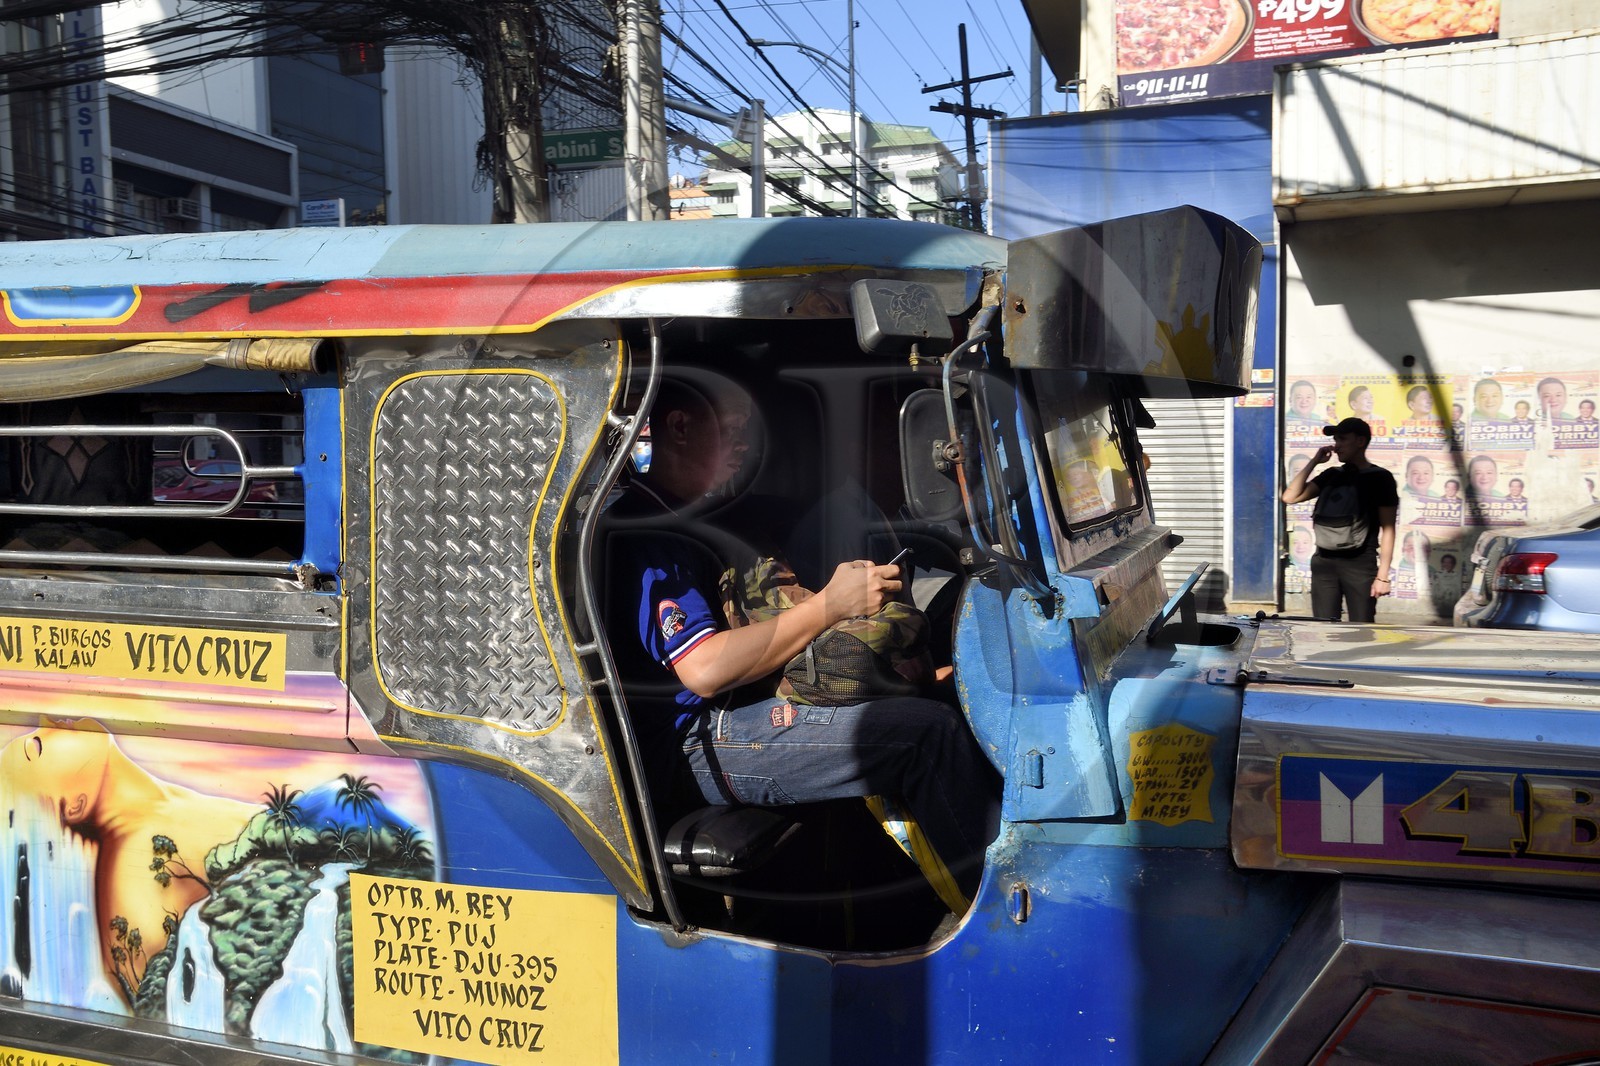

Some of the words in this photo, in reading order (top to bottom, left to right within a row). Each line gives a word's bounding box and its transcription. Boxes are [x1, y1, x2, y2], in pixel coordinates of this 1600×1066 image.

[1136, 73, 1209, 96] 911-11-11
[544, 139, 597, 159] abini
[608, 136, 624, 155] S
[1471, 424, 1533, 433] BOBBY
[1471, 432, 1533, 440] ESPIRITU
[49, 626, 112, 649] BURGOS
[34, 648, 97, 669] KALAW
[197, 636, 272, 682] CRUZ
[465, 892, 513, 921] REY
[448, 921, 497, 949] PUJ
[460, 978, 548, 1011] MUNOZ
[413, 1008, 472, 1042] VITO
[478, 1016, 545, 1053] CRUZ
